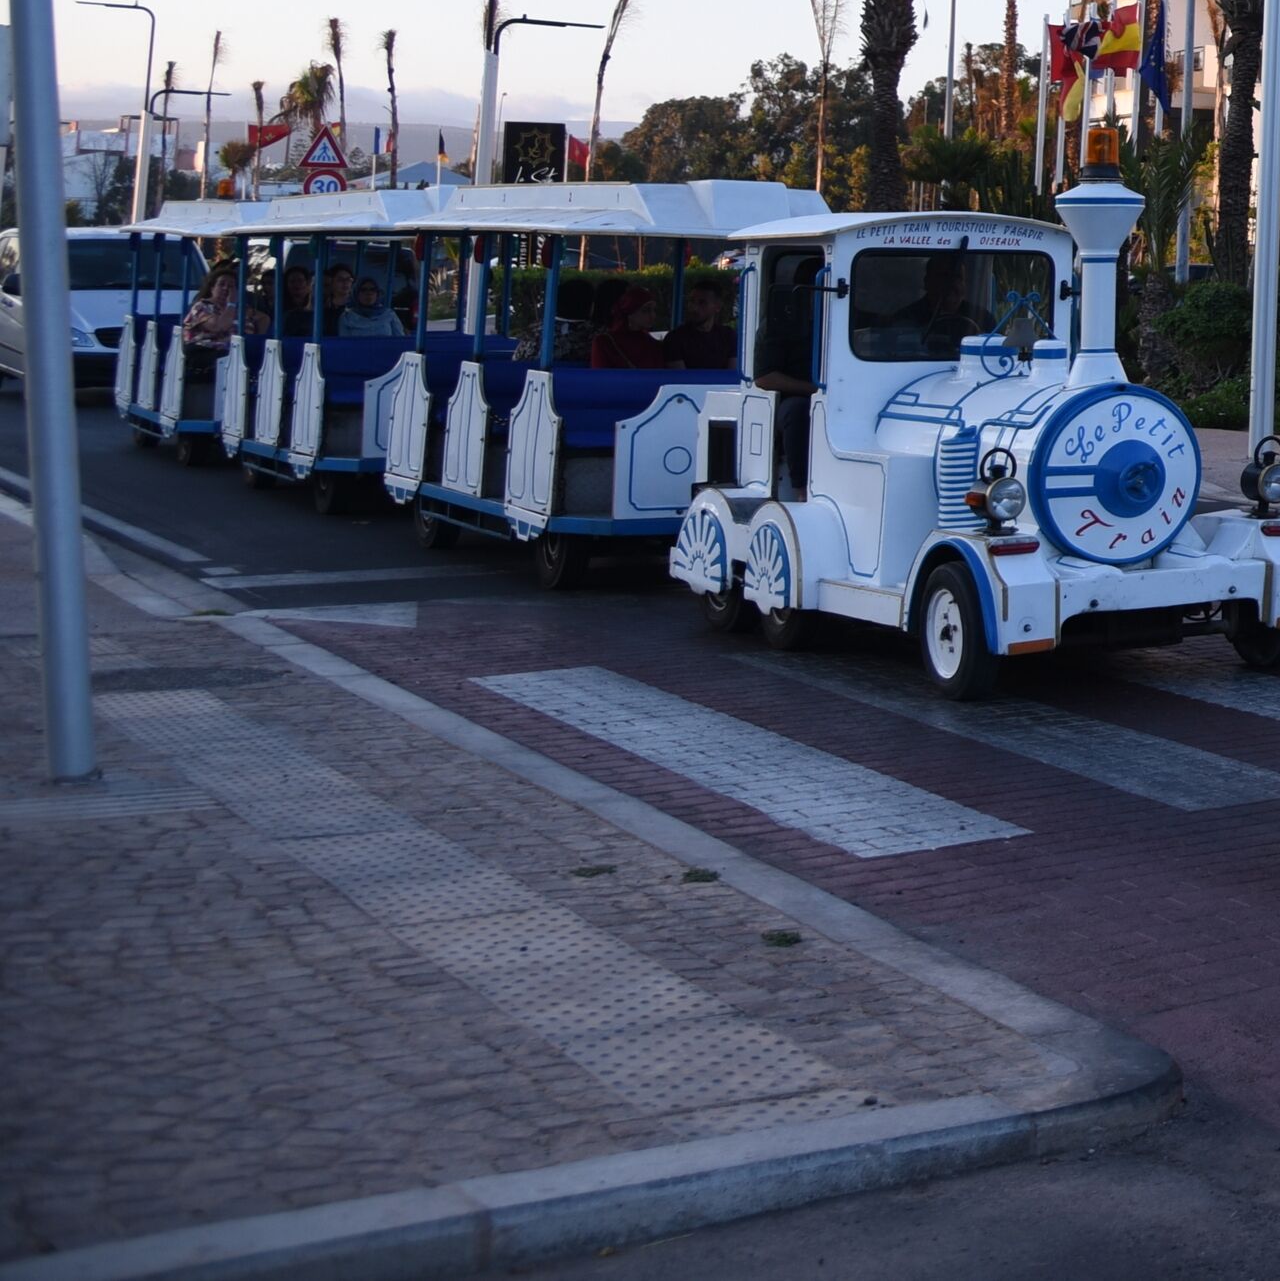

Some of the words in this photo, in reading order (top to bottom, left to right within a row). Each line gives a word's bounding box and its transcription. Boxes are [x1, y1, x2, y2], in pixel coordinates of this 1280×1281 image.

[312, 180, 339, 194] 30
[856, 228, 867, 239] LE
[870, 224, 898, 237] PETIT
[903, 221, 931, 233] TRAIN
[936, 221, 997, 234] TOURISTIQUE
[883, 236, 896, 245] LA
[937, 237, 952, 245] des
[980, 236, 1022, 246] OISEAUX
[1065, 425, 1106, 464] Le
[1112, 402, 1185, 459] Petit
[1075, 487, 1186, 550] Train
